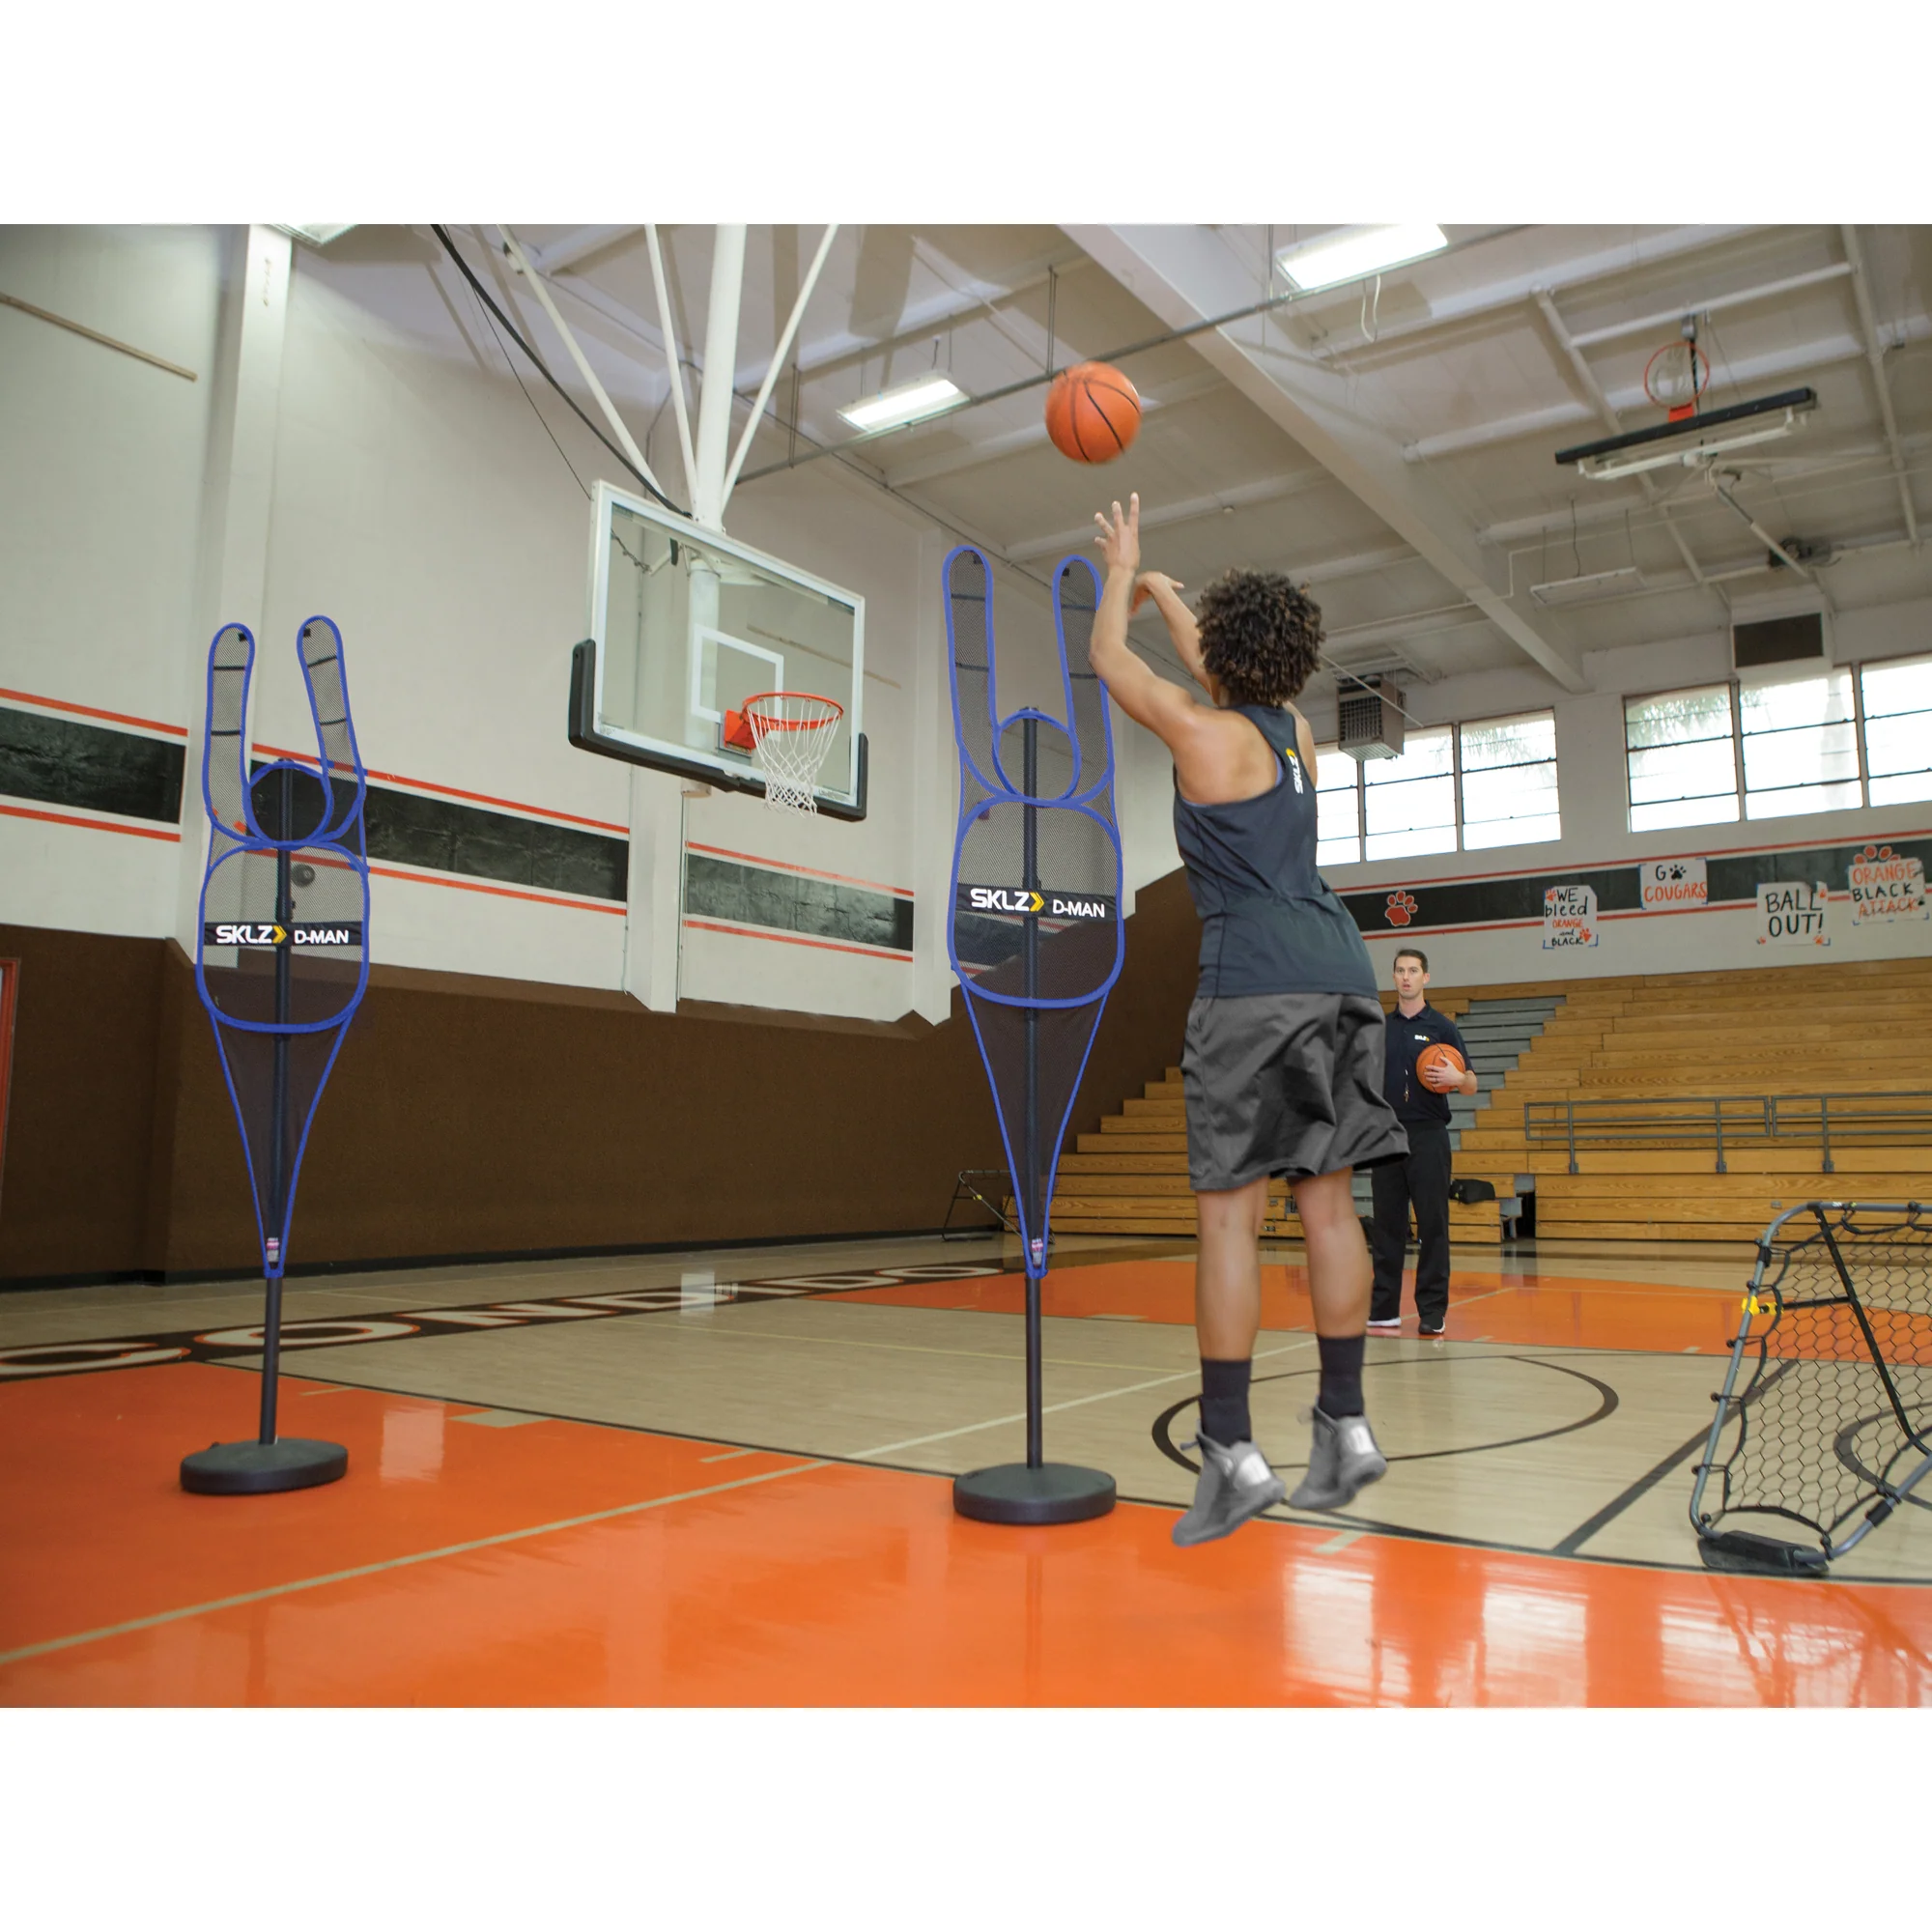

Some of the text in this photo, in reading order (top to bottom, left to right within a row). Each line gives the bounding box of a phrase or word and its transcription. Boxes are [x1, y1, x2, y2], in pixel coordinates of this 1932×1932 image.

[1288, 754, 1304, 794] SKLZ
[1853, 861, 1916, 886] ORANGE
[970, 888, 1105, 918] SKLZ D-MAN
[1556, 887, 1578, 902] WE
[1644, 881, 1708, 903] COUGARS
[1765, 888, 1823, 914] BALL
[1852, 882, 1914, 902] BLACK
[1546, 895, 1588, 918] bleed
[1859, 896, 1920, 920] ATTACK
[215, 924, 349, 944] SKLZ D-MAN
[1552, 918, 1583, 928] ORANGE
[1769, 913, 1823, 938] OUT!
[1551, 937, 1583, 947] BLACK
